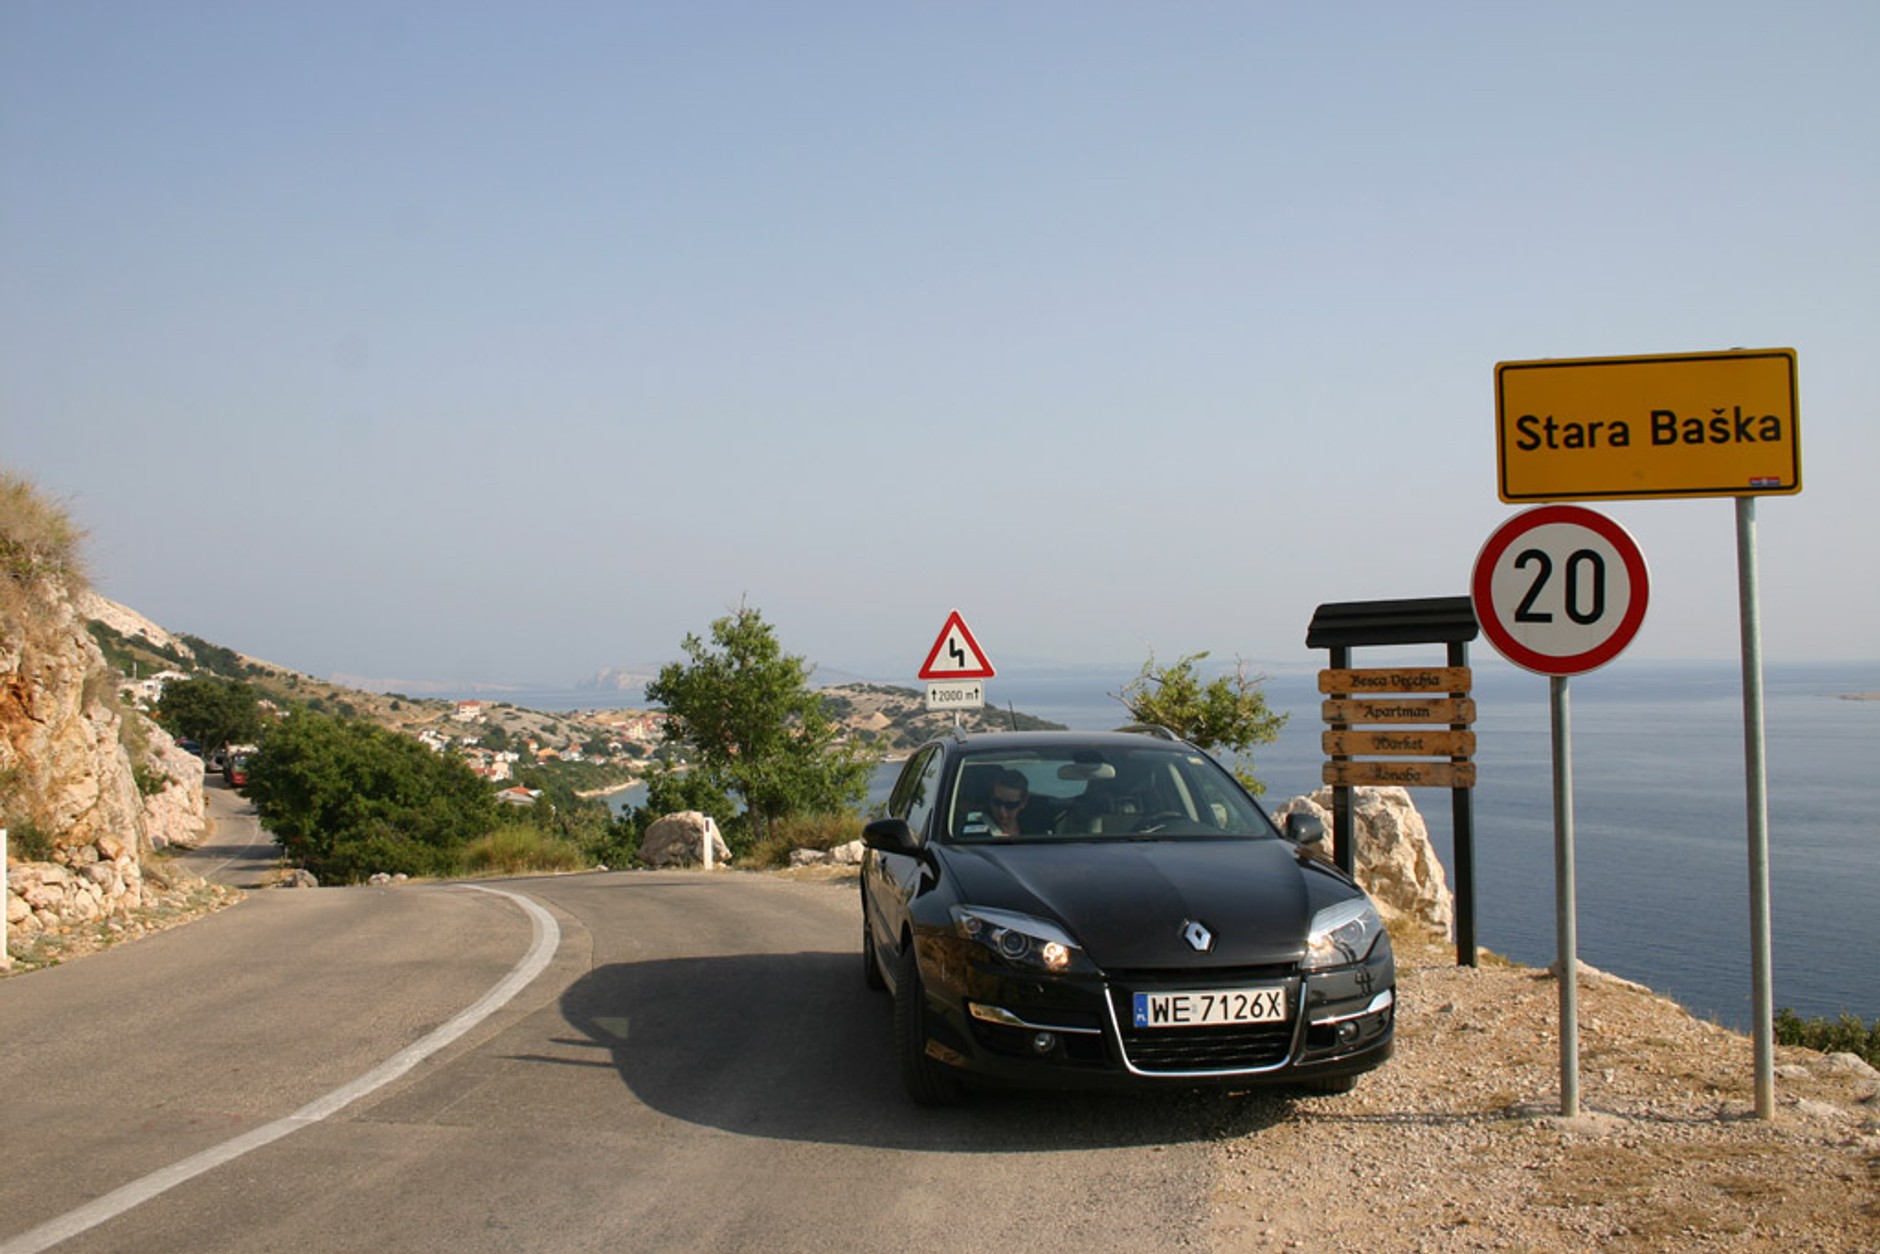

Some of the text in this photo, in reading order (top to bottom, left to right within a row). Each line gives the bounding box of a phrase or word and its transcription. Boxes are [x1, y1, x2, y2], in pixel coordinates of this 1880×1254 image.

[1516, 406, 1781, 450] Stara Baška
[1514, 549, 1605, 625] 20
[938, 691, 963, 701] 2000
[1364, 704, 1430, 719] Apartman
[1152, 992, 1280, 1022] WE 7126X
